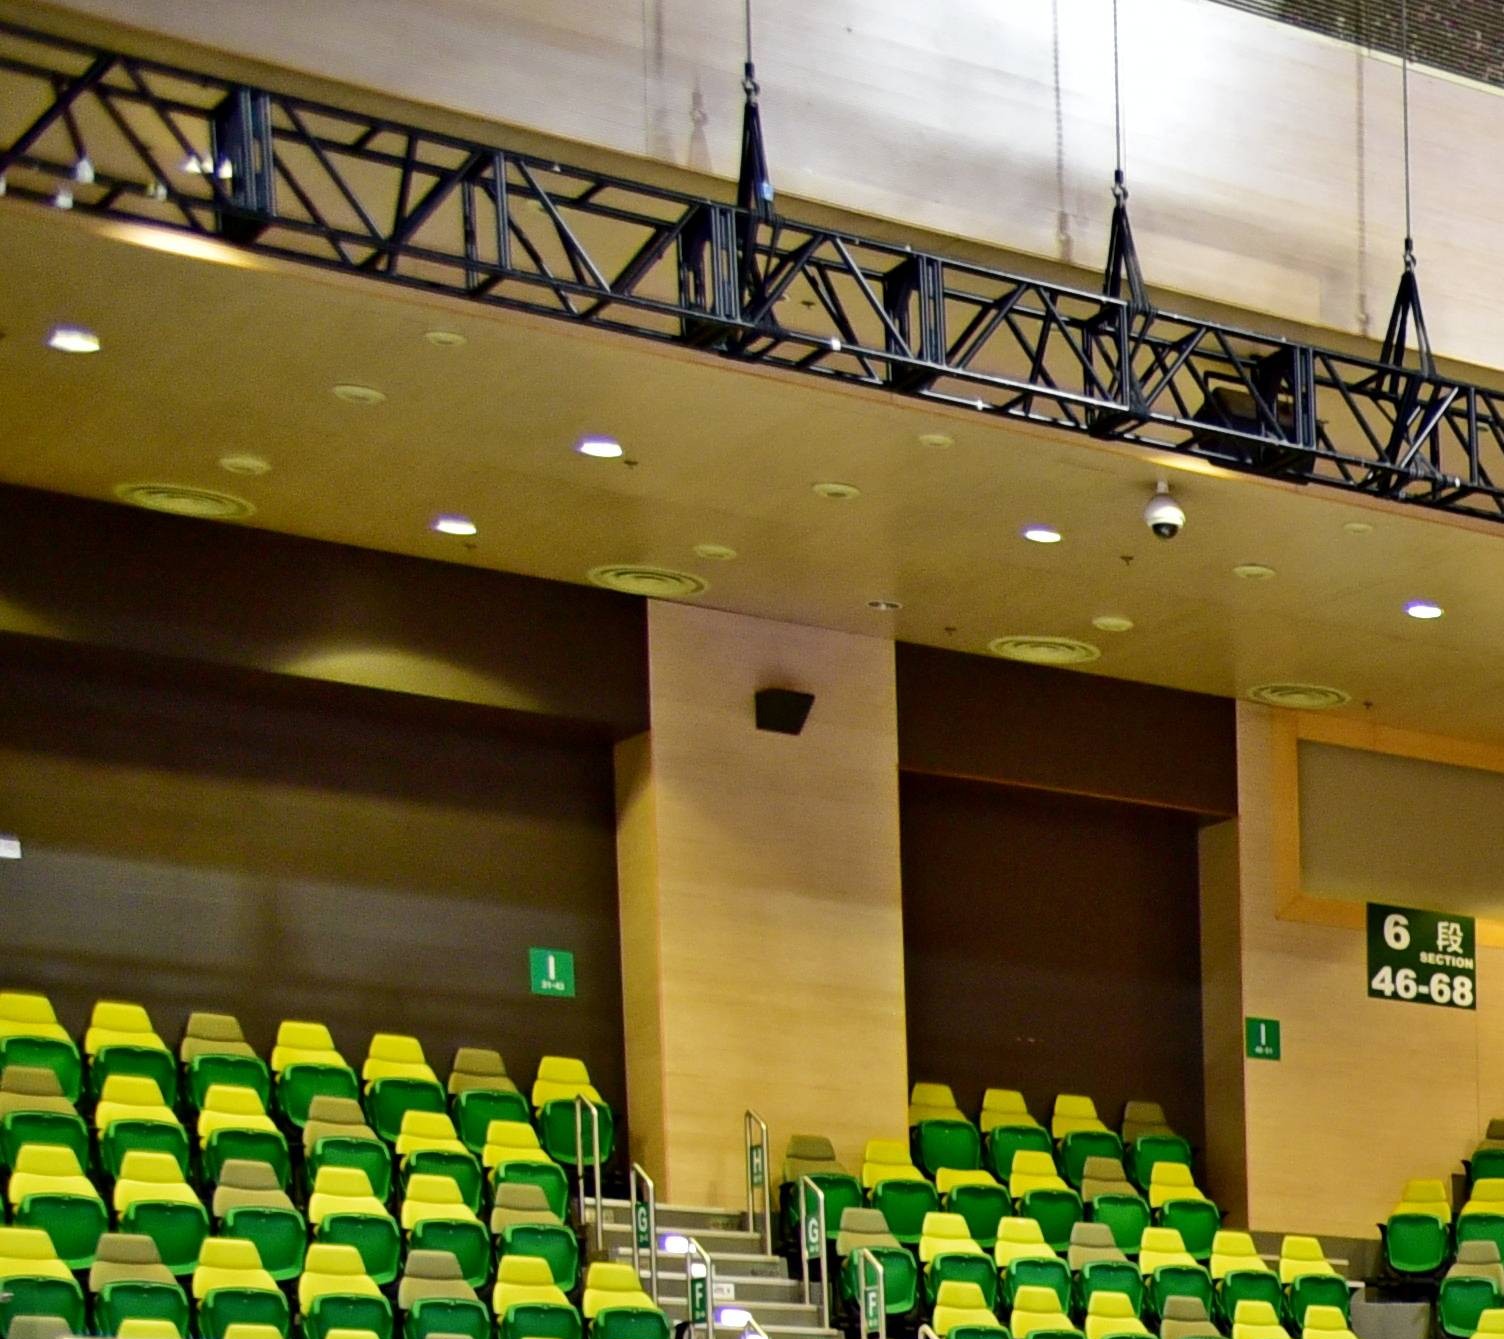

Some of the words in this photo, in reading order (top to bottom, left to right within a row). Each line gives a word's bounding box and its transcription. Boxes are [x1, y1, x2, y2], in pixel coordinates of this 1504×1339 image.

[1383, 913, 1411, 951] 6
[1436, 921, 1464, 954] 段
[1419, 951, 1474, 970] SECTION
[1371, 965, 1474, 1007] 46-68
[638, 1205, 648, 1233] G
[808, 1218, 820, 1243] G
[695, 1282, 704, 1310] F
[867, 1291, 877, 1318] F
